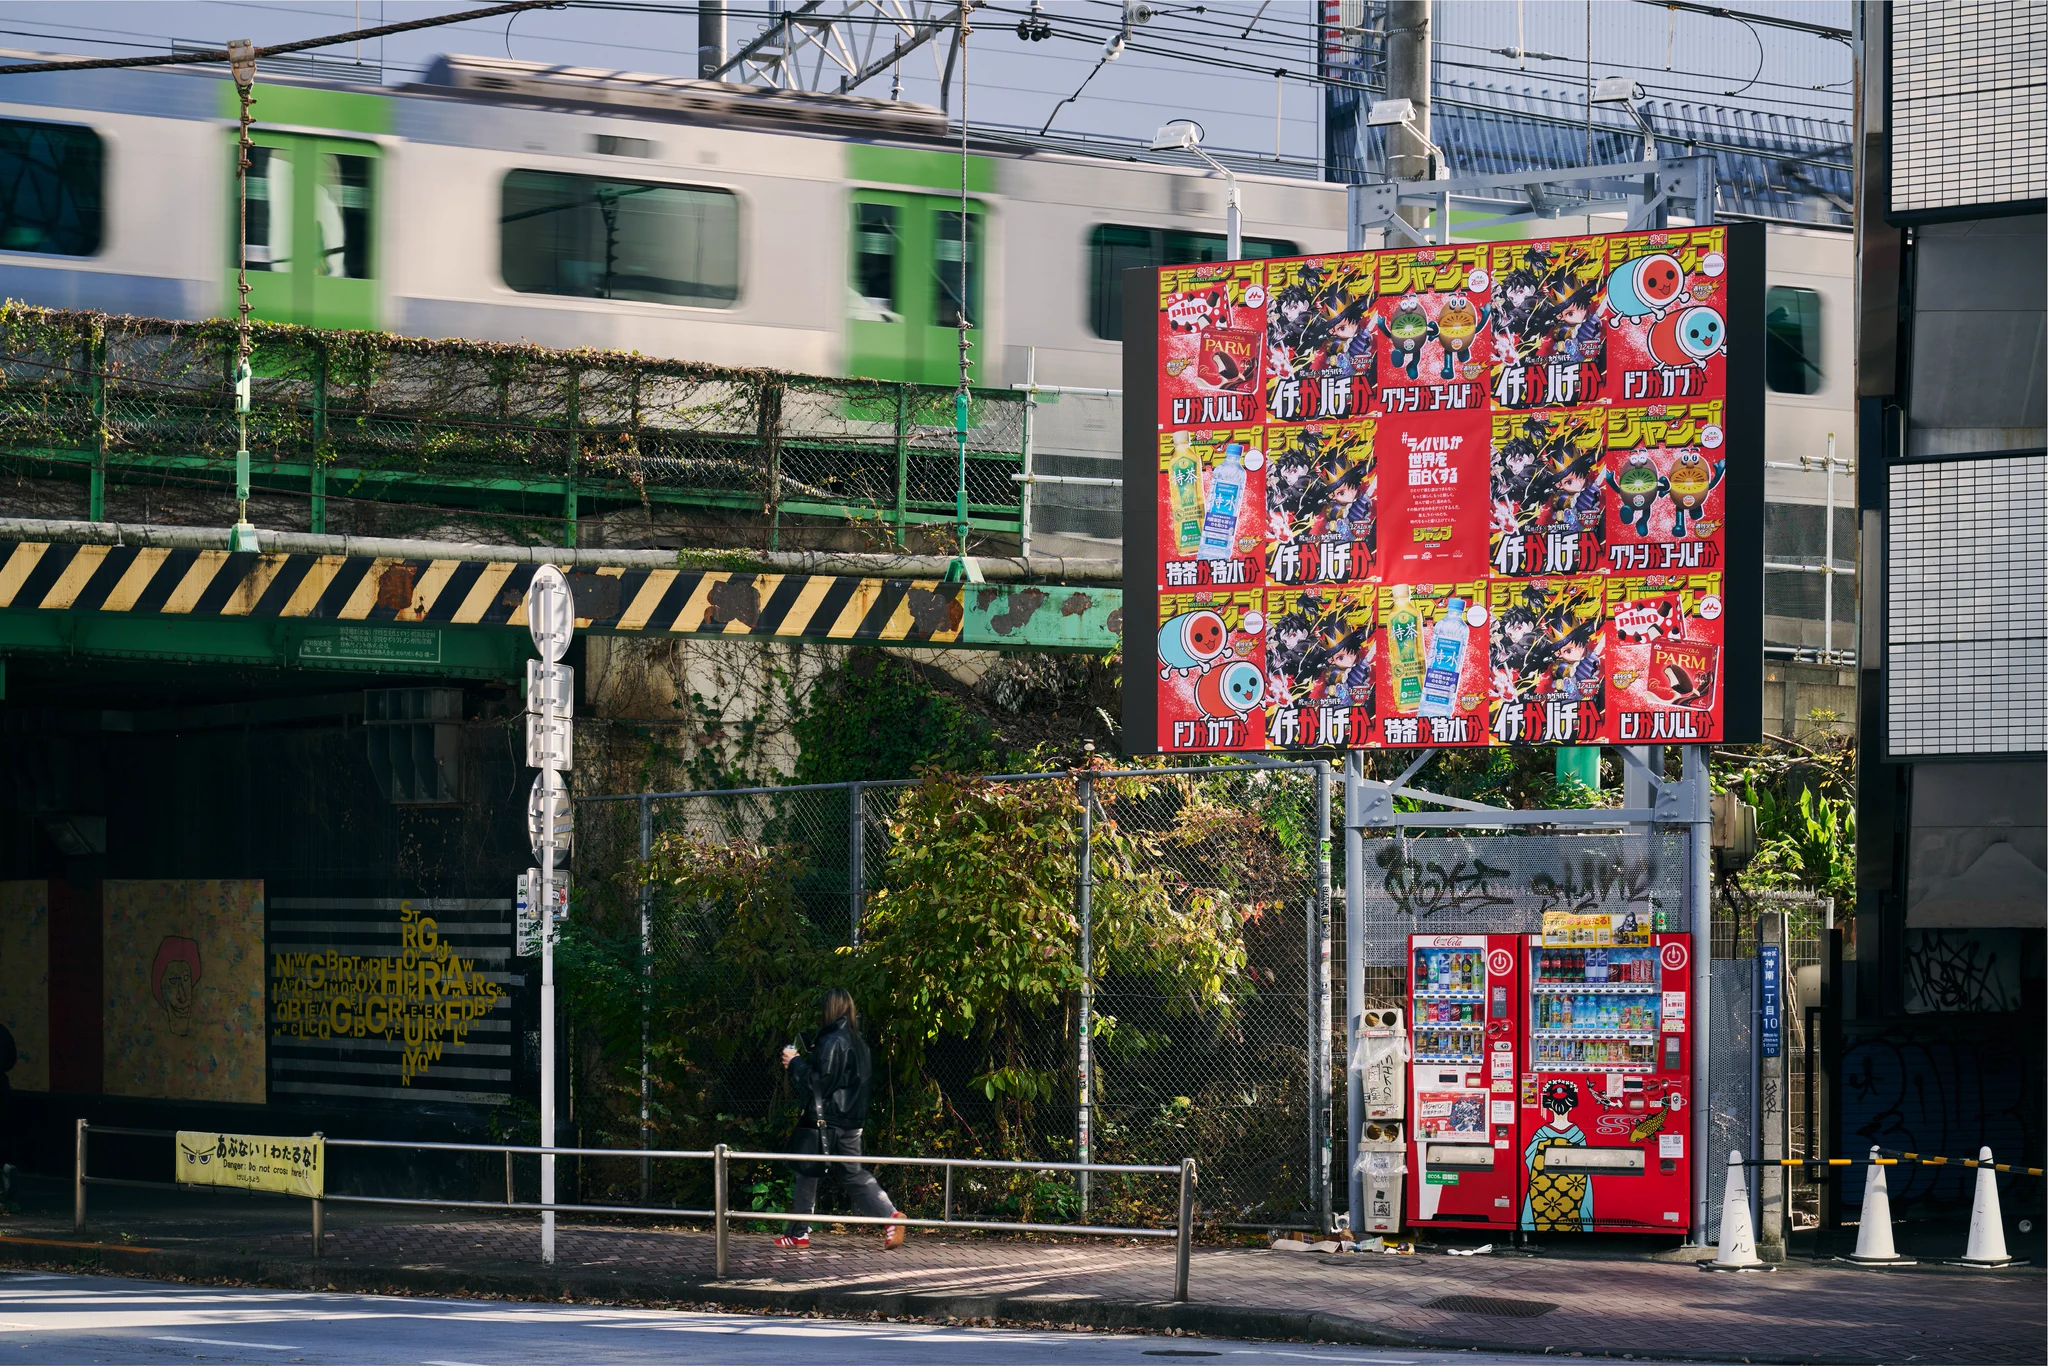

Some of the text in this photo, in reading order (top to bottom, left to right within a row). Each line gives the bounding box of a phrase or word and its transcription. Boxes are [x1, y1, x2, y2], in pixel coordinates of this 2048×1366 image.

[1418, 250, 1435, 261] 少年
[1379, 244, 1489, 296] ジャンプ
[1171, 303, 1207, 318] pino
[1205, 339, 1251, 356] PARM
[1494, 362, 1602, 406] イチかバチか
[1624, 366, 1707, 399] ドンかガツか
[1173, 395, 1258, 424] ピノかパルムか
[1270, 375, 1373, 418] イチかバチか
[1381, 382, 1486, 413] グリーンかゴールドか
[1648, 404, 1666, 416] 少年
[1607, 401, 1723, 450] ジャンプ
[1402, 432, 1463, 452] #ライバルが
[1408, 452, 1447, 469] 世界を
[1172, 468, 1198, 486] 特茶
[1408, 467, 1458, 486] 面白くする
[1413, 525, 1452, 542] ジャンプ
[1270, 541, 1372, 582] イチかバチか
[1494, 531, 1601, 575] イチかバチか
[1609, 541, 1719, 570] グリーンかゴールドか
[1165, 557, 1260, 586] 特茶か特水か
[1391, 622, 1418, 641] 特茶
[1619, 612, 1658, 627] pino
[1656, 651, 1706, 670] PARM
[1174, 720, 1249, 747] ドンかガツか
[1269, 706, 1371, 745] イチかバチか
[1384, 716, 1484, 744] 特茶か特水か
[1493, 700, 1601, 742] イチかバチか
[1620, 711, 1714, 739] ピノかパルムか
[1433, 936, 1462, 946] Coca-Cola
[1765, 959, 1775, 1015] 神南一丁目
[1763, 1018, 1778, 1029] 10
[223, 1159, 246, 1170] Danger:
[249, 1162, 256, 1171] Do
[259, 1164, 270, 1173] not
